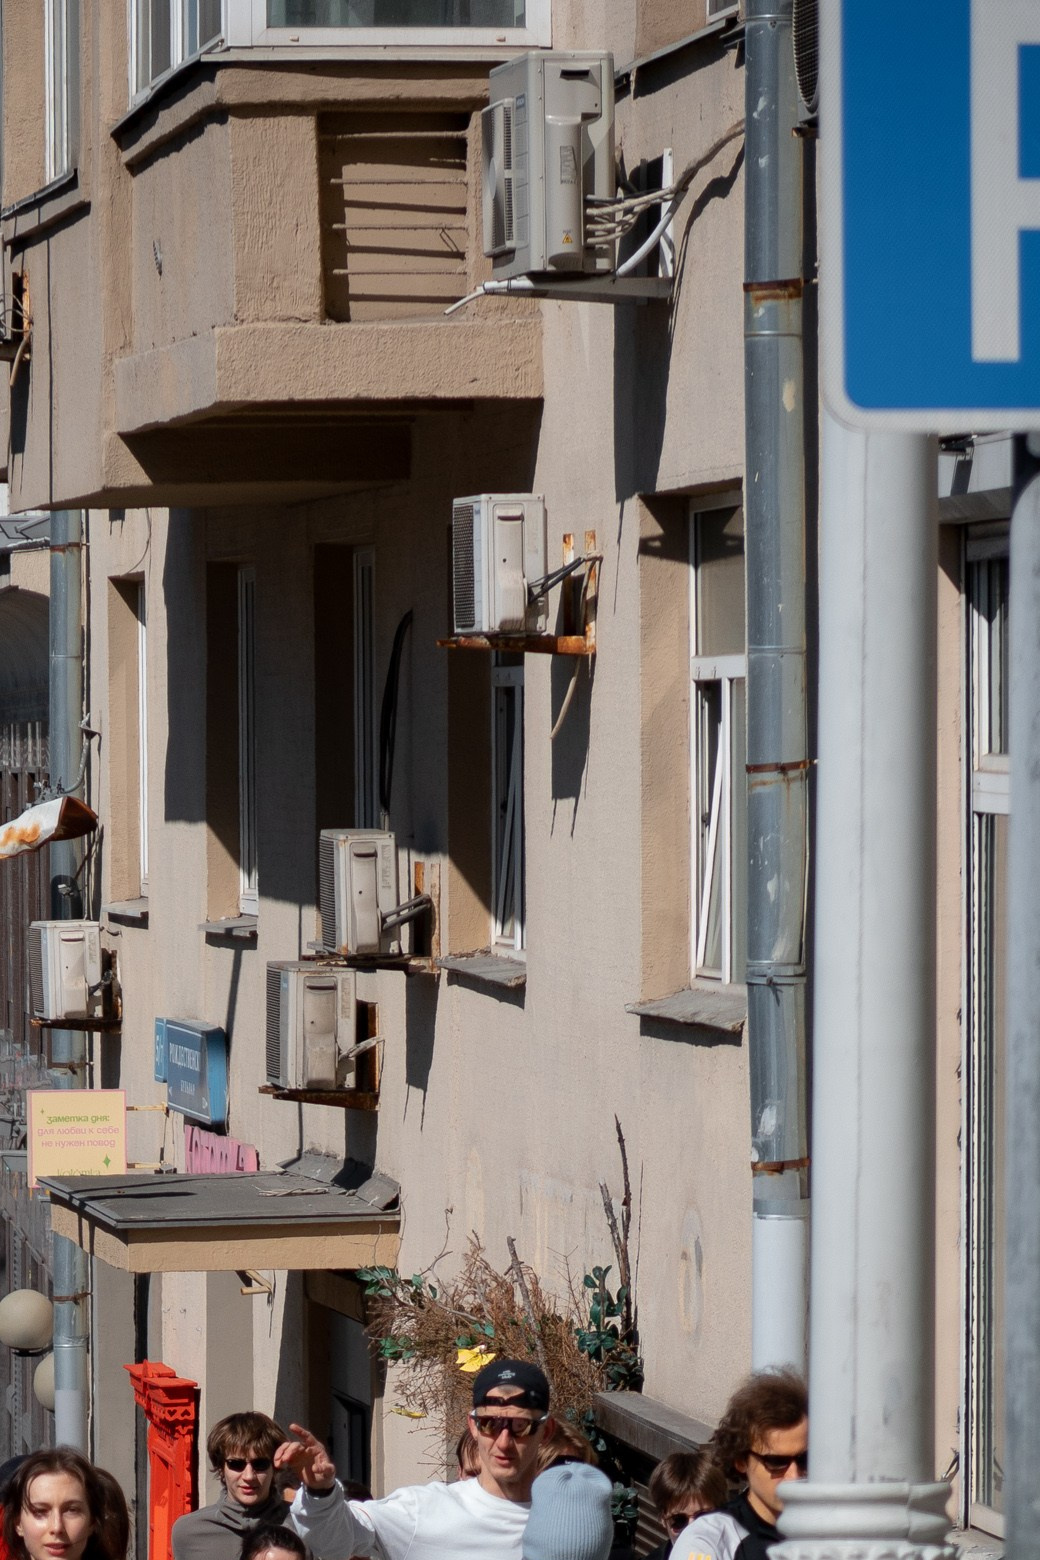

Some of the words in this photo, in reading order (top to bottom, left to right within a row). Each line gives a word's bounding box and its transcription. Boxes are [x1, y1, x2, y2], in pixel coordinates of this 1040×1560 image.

[46, 1115, 89, 1125] заметка
[37, 1128, 55, 1137] для
[56, 1127, 87, 1135] любви
[96, 1125, 120, 1134] себе
[41, 1140, 53, 1148] не
[55, 1140, 86, 1149] нужен
[86, 1139, 116, 1149] повод
